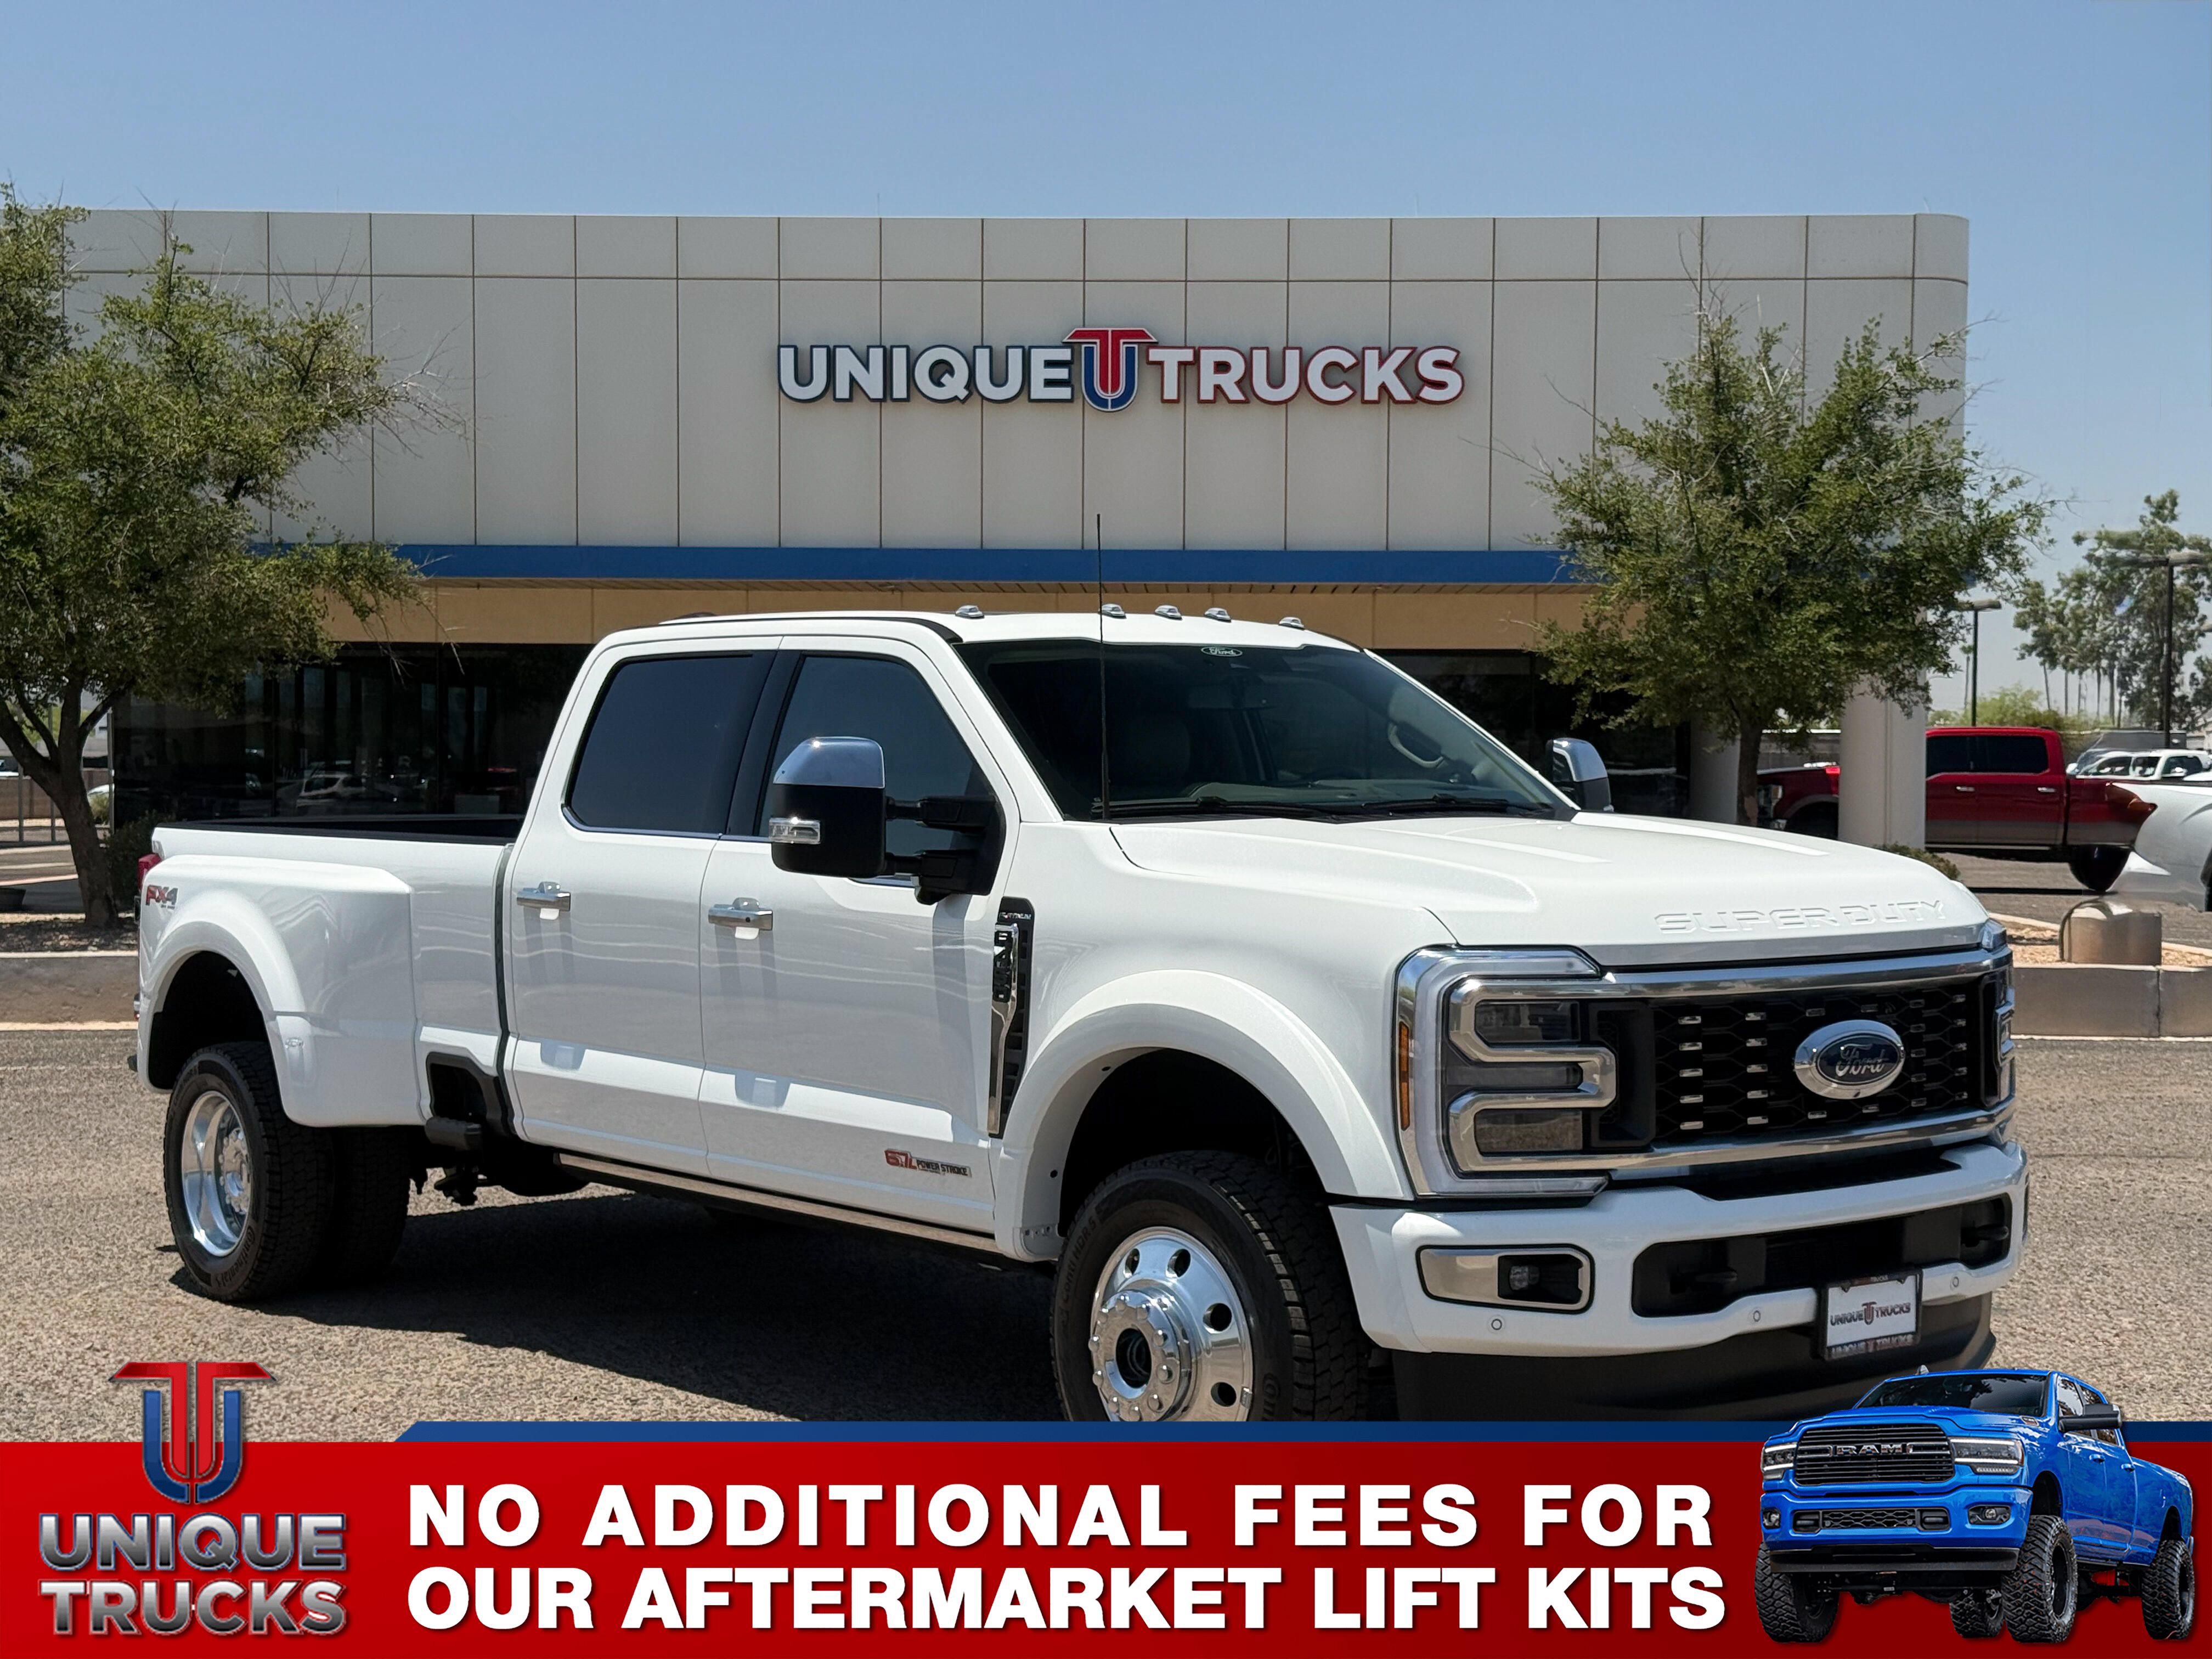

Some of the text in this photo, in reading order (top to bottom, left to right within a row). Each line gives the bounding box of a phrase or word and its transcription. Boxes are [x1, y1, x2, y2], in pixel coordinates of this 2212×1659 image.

[777, 343, 1075, 404] UNIQUE
[1146, 345, 1465, 405] TRUCKS
[1209, 647, 1236, 655] Ford
[145, 885, 178, 906] FX4
[1655, 900, 1946, 934] SUPER DUTY
[1835, 1042, 1889, 1077] Ford
[917, 1159, 940, 1170] POWER
[940, 1163, 968, 1176] STROKE
[1830, 1310, 1864, 1327] UNIQUE
[1874, 1302, 1911, 1319] TRUCKS
